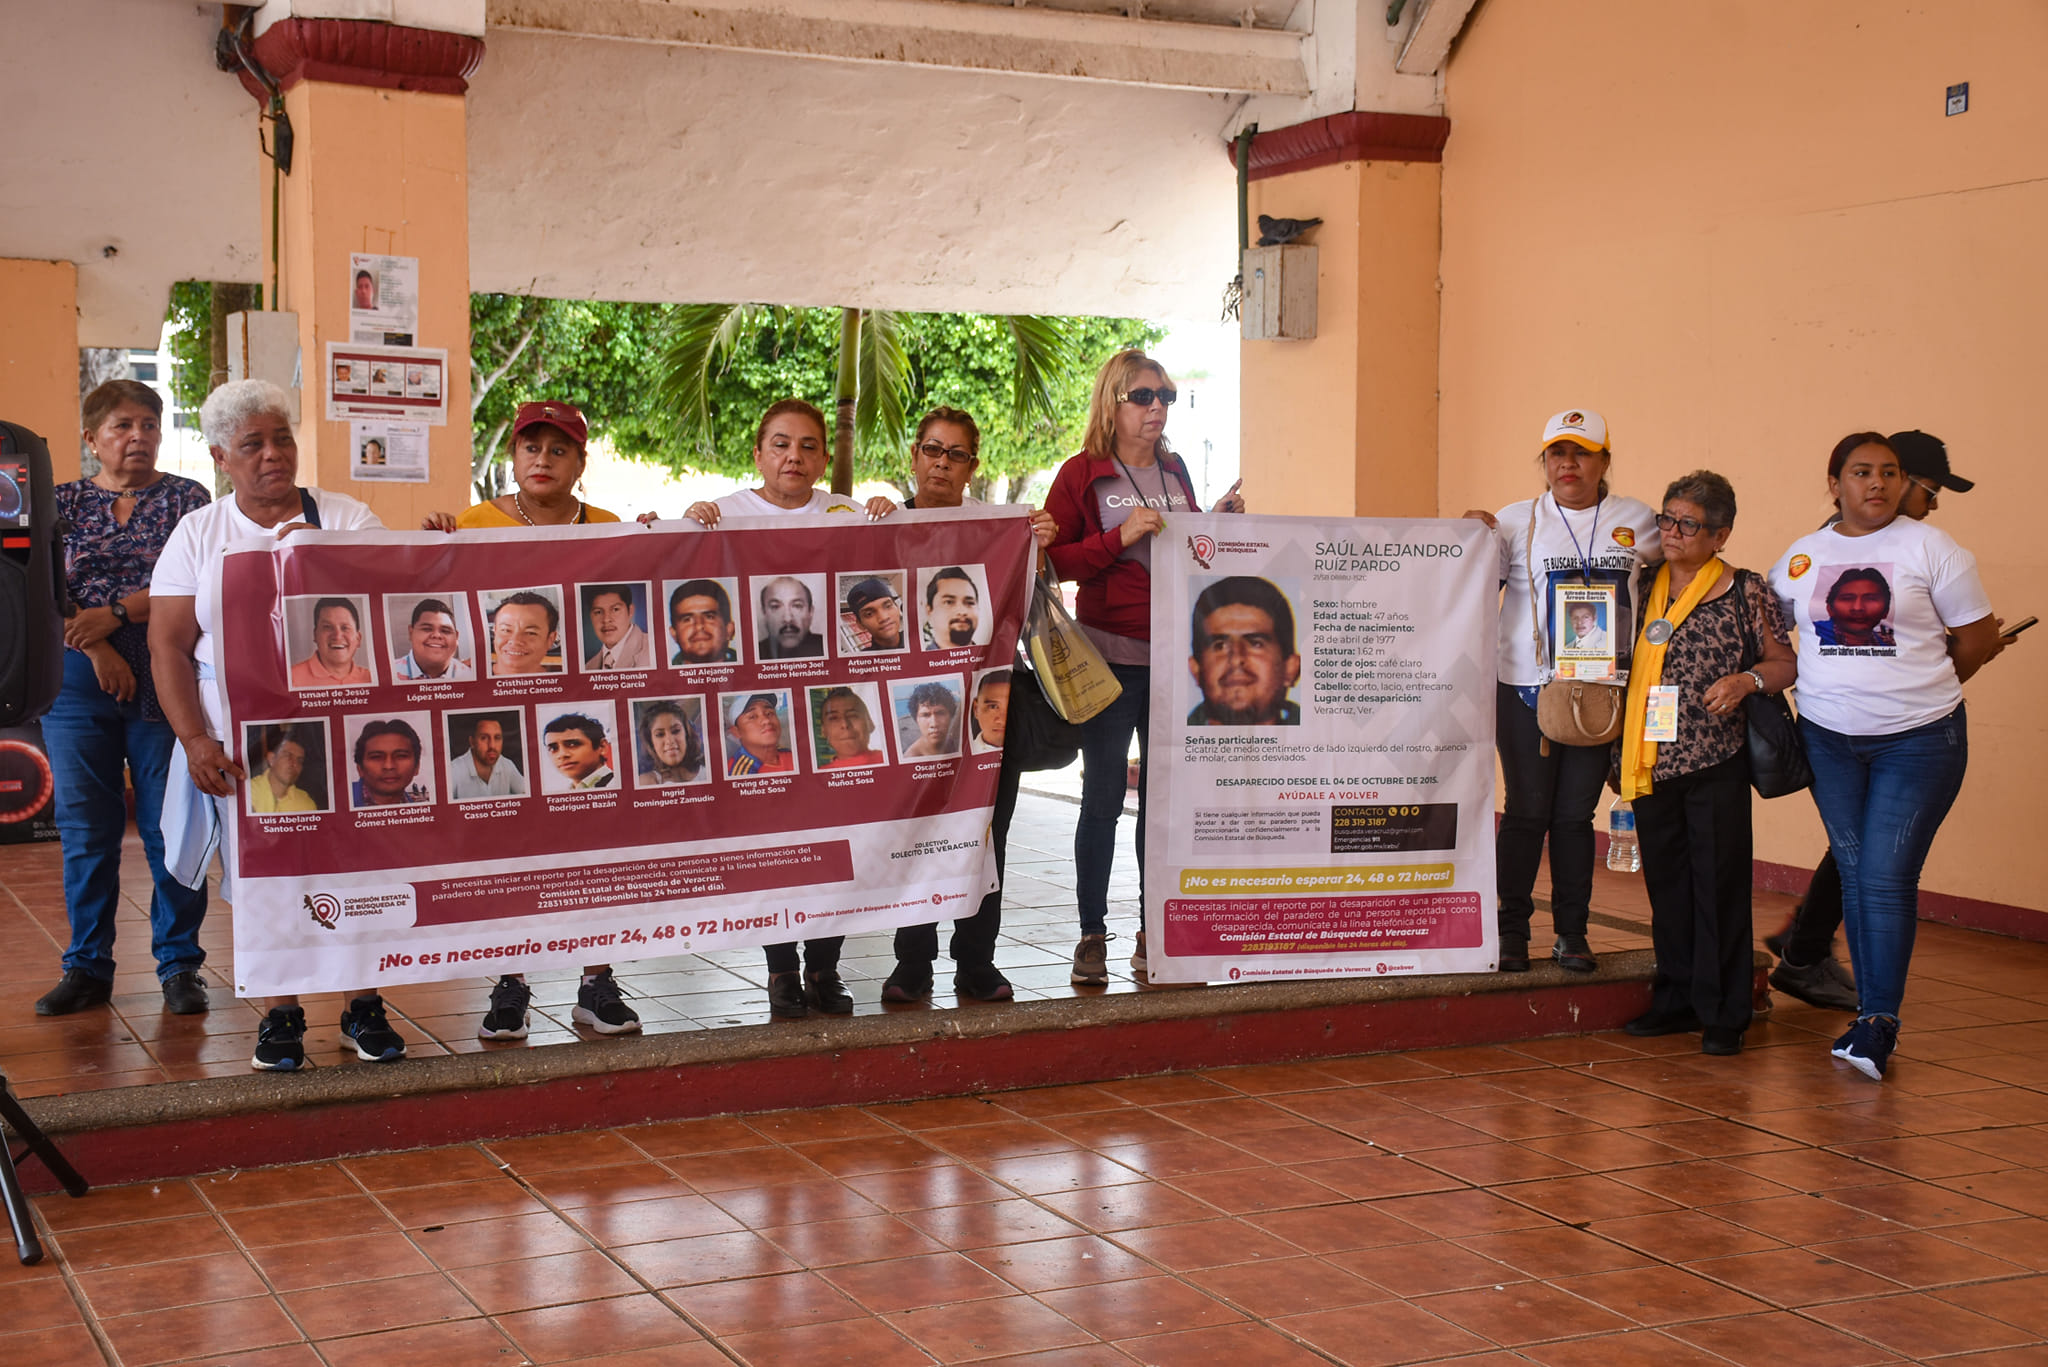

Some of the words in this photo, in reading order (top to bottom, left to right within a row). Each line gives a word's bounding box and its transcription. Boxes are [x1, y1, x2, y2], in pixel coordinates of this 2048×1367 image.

[1106, 494, 1160, 508] Calvin
[1315, 539, 1358, 556] SAÚL
[1362, 543, 1463, 557] ALEJANDRO
[1314, 556, 1347, 571] RUÍZ
[1351, 560, 1400, 571] PARDO
[1544, 558, 1550, 570] TE
[1551, 554, 1578, 570] BUSCARÉ
[1313, 600, 1338, 608] Sexo:
[1340, 600, 1378, 608] hombre
[1314, 612, 1337, 620] Edad
[1340, 612, 1372, 620] actual:
[1374, 612, 1384, 620] 47
[1387, 612, 1409, 620] años
[1314, 623, 1342, 632] Fecha
[1344, 623, 1356, 632] de
[1358, 624, 1414, 632] nacimiento:
[1314, 635, 1325, 644] 28
[1326, 635, 1338, 644] de
[1340, 635, 1360, 644] abril
[1362, 635, 1374, 644] de
[1376, 635, 1396, 644] 1977
[1314, 647, 1355, 655] Estatura:
[780, 662, 808, 671] Higinio
[1314, 659, 1338, 667] Color
[1340, 659, 1352, 667] de
[1354, 659, 1376, 669] ojos:
[1379, 659, 1398, 667] café
[1399, 659, 1422, 667] claro
[679, 668, 696, 676] Saúl
[698, 666, 734, 677] Alejandro
[758, 671, 788, 679] Romero
[848, 665, 879, 675] Huguett
[589, 673, 618, 681] Alfredo
[620, 672, 648, 680] Román
[1314, 670, 1338, 679] Color
[1340, 670, 1353, 679] de
[1355, 670, 1375, 681] piel:
[1414, 670, 1437, 679] clara
[496, 678, 534, 687] Cristhian
[535, 677, 558, 685] Omar
[593, 682, 619, 691] Arroyo
[1314, 682, 1352, 691] Cabello:
[1353, 682, 1379, 692] corto,
[1381, 682, 1404, 692] lacio,
[1405, 682, 1454, 691] entrecano
[299, 690, 329, 698] Ismael
[345, 688, 370, 696] Jesús
[493, 686, 527, 695] Sánchez
[529, 685, 563, 694] Canseco
[302, 699, 331, 707] Pastor
[333, 697, 368, 706] Méndez
[407, 693, 432, 703] López
[434, 691, 464, 700] Montor
[1314, 694, 1342, 704] Lugar
[1344, 694, 1356, 702] de
[1358, 694, 1422, 704] desaparición:
[1314, 705, 1356, 716] Veracruz,
[1357, 705, 1374, 714] Ver.
[1185, 736, 1216, 744] Señas
[1218, 736, 1278, 747] particulares:
[832, 770, 845, 778] Jair
[847, 769, 873, 777] Ozmar
[912, 770, 936, 779] Gómez
[732, 780, 757, 788] Erving
[828, 778, 854, 787] Muñoz
[1216, 778, 1285, 786] DESAPARECIDO
[1362, 777, 1404, 785] OCTUBRE
[546, 794, 585, 803] Francisco
[587, 792, 618, 800] Damián
[662, 789, 685, 798] Ingrid
[1278, 790, 1324, 800] AYÚDALE
[1328, 792, 1336, 800] A
[1338, 792, 1378, 800] VOLVER
[592, 800, 616, 809] Bazán
[680, 795, 715, 804] Zamudio
[460, 802, 493, 811] Roberto
[495, 800, 521, 808] Carlos
[358, 808, 398, 818] Praxedes
[399, 806, 430, 815] Gabriel
[464, 810, 489, 819] Casso
[490, 808, 518, 817] Castro
[1334, 807, 1384, 816] CONTACTO
[259, 816, 277, 824] Luis
[279, 814, 321, 823] Abelardo
[354, 818, 385, 827] Gómez
[1334, 818, 1350, 826] 228
[1352, 818, 1366, 826] 319
[1368, 818, 1386, 826] 3187
[264, 824, 294, 833] Santos
[296, 823, 317, 832] Cruz
[914, 839, 949, 848] COLECTIVO
[891, 849, 922, 858] SOLECITO
[936, 840, 979, 853] VERACRUZ
[1185, 876, 1208, 890] ¡No
[1211, 878, 1227, 887] es
[1230, 874, 1293, 886] necesario
[1296, 876, 1344, 887] esperar
[1345, 873, 1365, 885] 24,
[1368, 872, 1384, 883] 48
[1387, 874, 1395, 882] o
[1398, 872, 1412, 882] 72
[1414, 871, 1449, 882] horas!
[540, 887, 580, 897] Comisión
[582, 884, 612, 894] Estatal
[614, 883, 625, 891] de
[627, 879, 668, 892] Búsqueda
[670, 878, 681, 886] de
[684, 875, 722, 885] Veracruz:
[380, 952, 413, 972] ¡No
[419, 952, 441, 965] es
[447, 939, 542, 962] necesario
[547, 934, 616, 955] esperar
[620, 928, 647, 946] 24,
[652, 925, 675, 940] 48
[680, 926, 691, 938] o
[697, 920, 717, 936] 72
[722, 914, 778, 933] horas!
